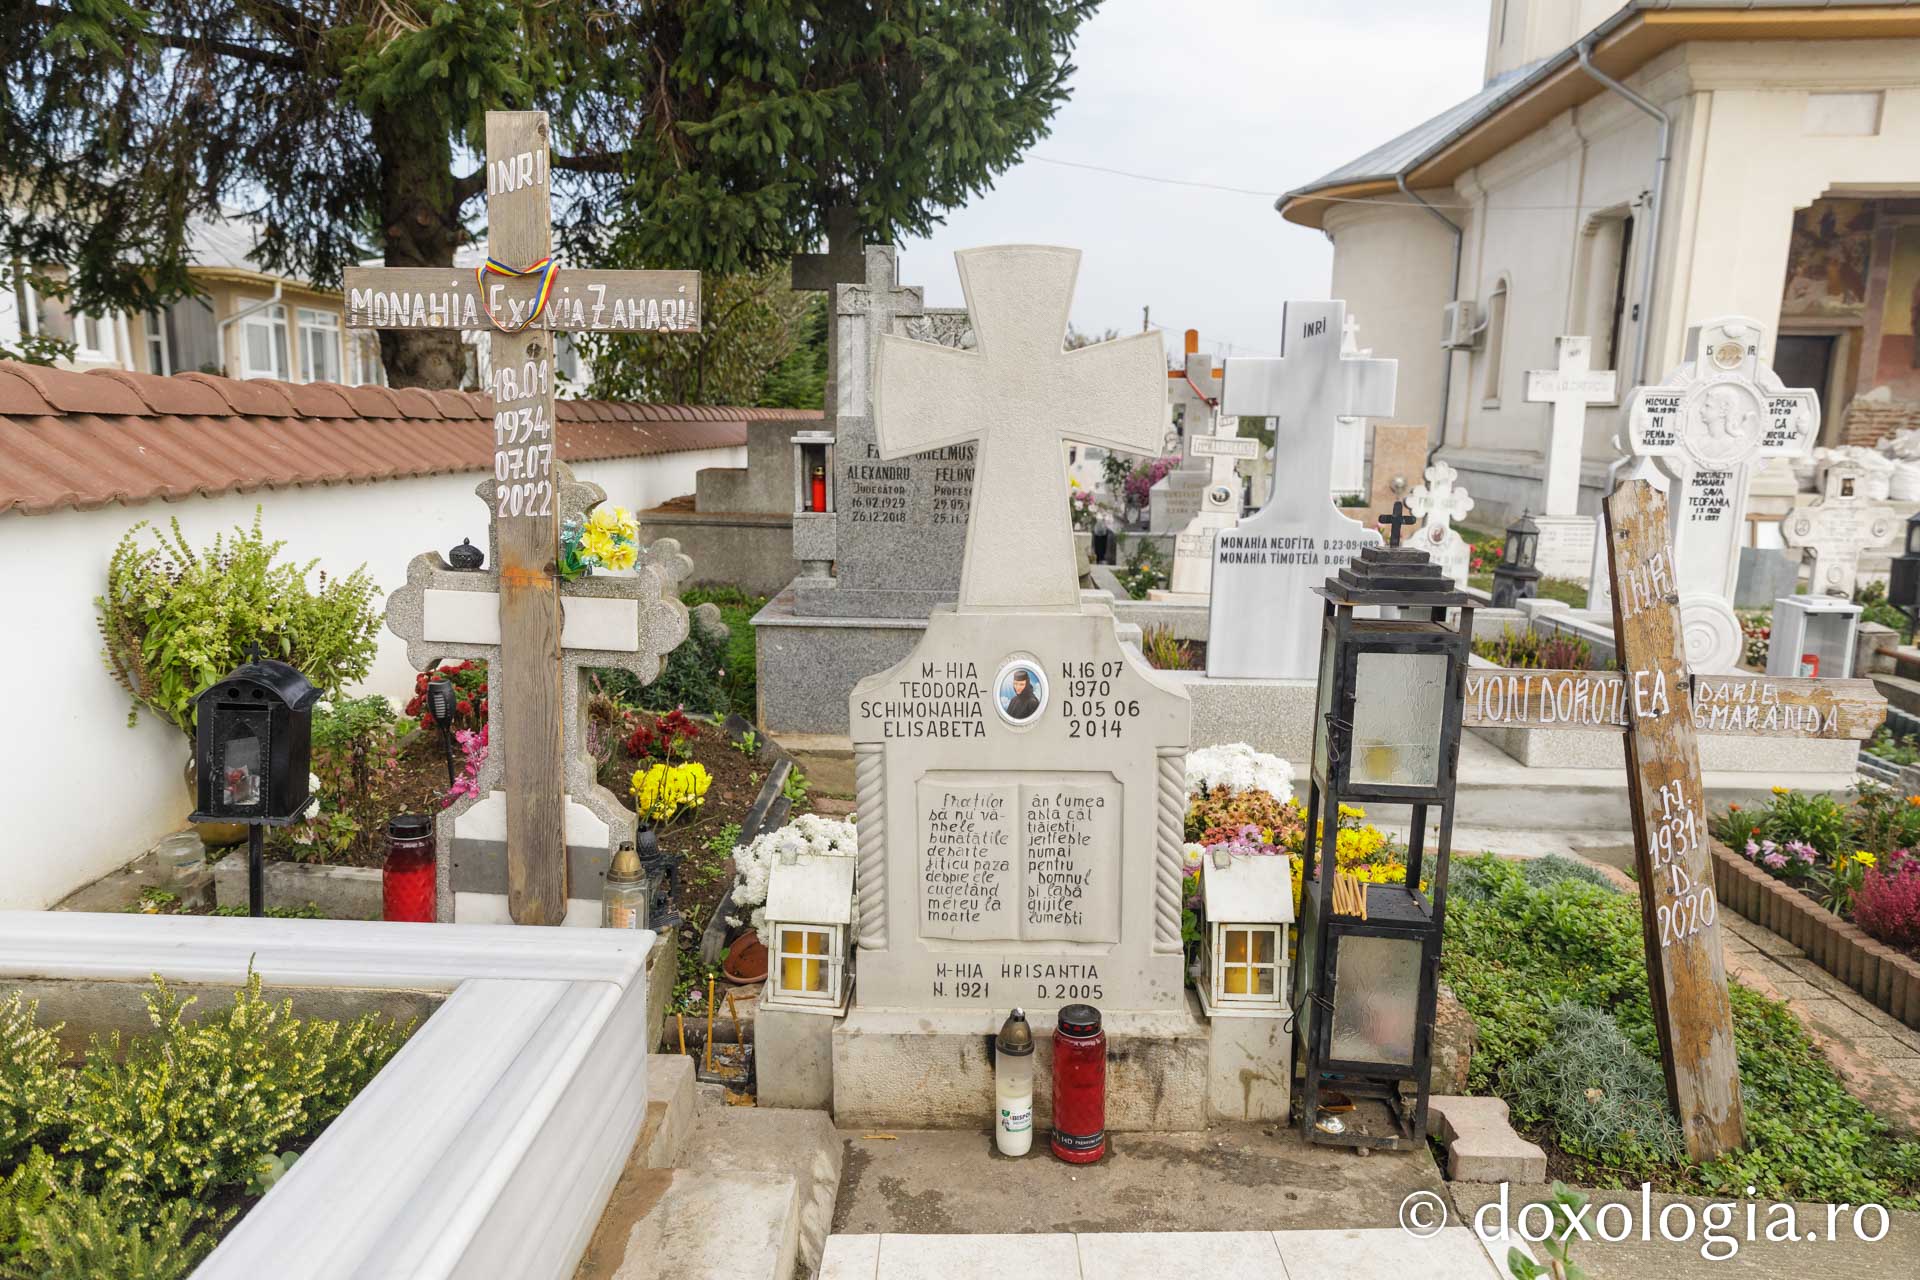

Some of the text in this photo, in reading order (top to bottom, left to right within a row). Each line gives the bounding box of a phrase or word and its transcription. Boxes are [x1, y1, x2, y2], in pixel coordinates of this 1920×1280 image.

[489, 149, 546, 196] INRI
[1303, 316, 1327, 339] INRI
[492, 359, 549, 403] 18.01
[494, 405, 550, 446] 1934
[495, 443, 553, 483] 07.07
[847, 465, 910, 481] ALEXANDRU
[497, 480, 552, 518] 2022
[853, 511, 906, 523] 26.12.2018
[922, 662, 978, 679] M-HIA
[900, 681, 988, 699] TEODORA-
[1069, 681, 1111, 698] 1970
[861, 701, 983, 719] SCHIMONAHIA
[1082, 700, 1106, 718] 05
[1114, 700, 1141, 717] 06
[1694, 703, 1839, 733] SMARANDA
[884, 721, 986, 738] ELISABETA
[1069, 720, 1122, 739] 2014
[1056, 793, 1104, 808] lumea
[1649, 809, 1698, 870] 1931
[1028, 845, 1071, 858] numai
[1028, 857, 1073, 874] pentru
[1671, 864, 1698, 897] D.
[928, 909, 980, 922] moarte
[1657, 887, 1715, 948] 2020
[936, 963, 1099, 980] M-HIA HRISANTIA
[955, 982, 990, 998] 1921
[1056, 984, 1104, 1000] 2005
